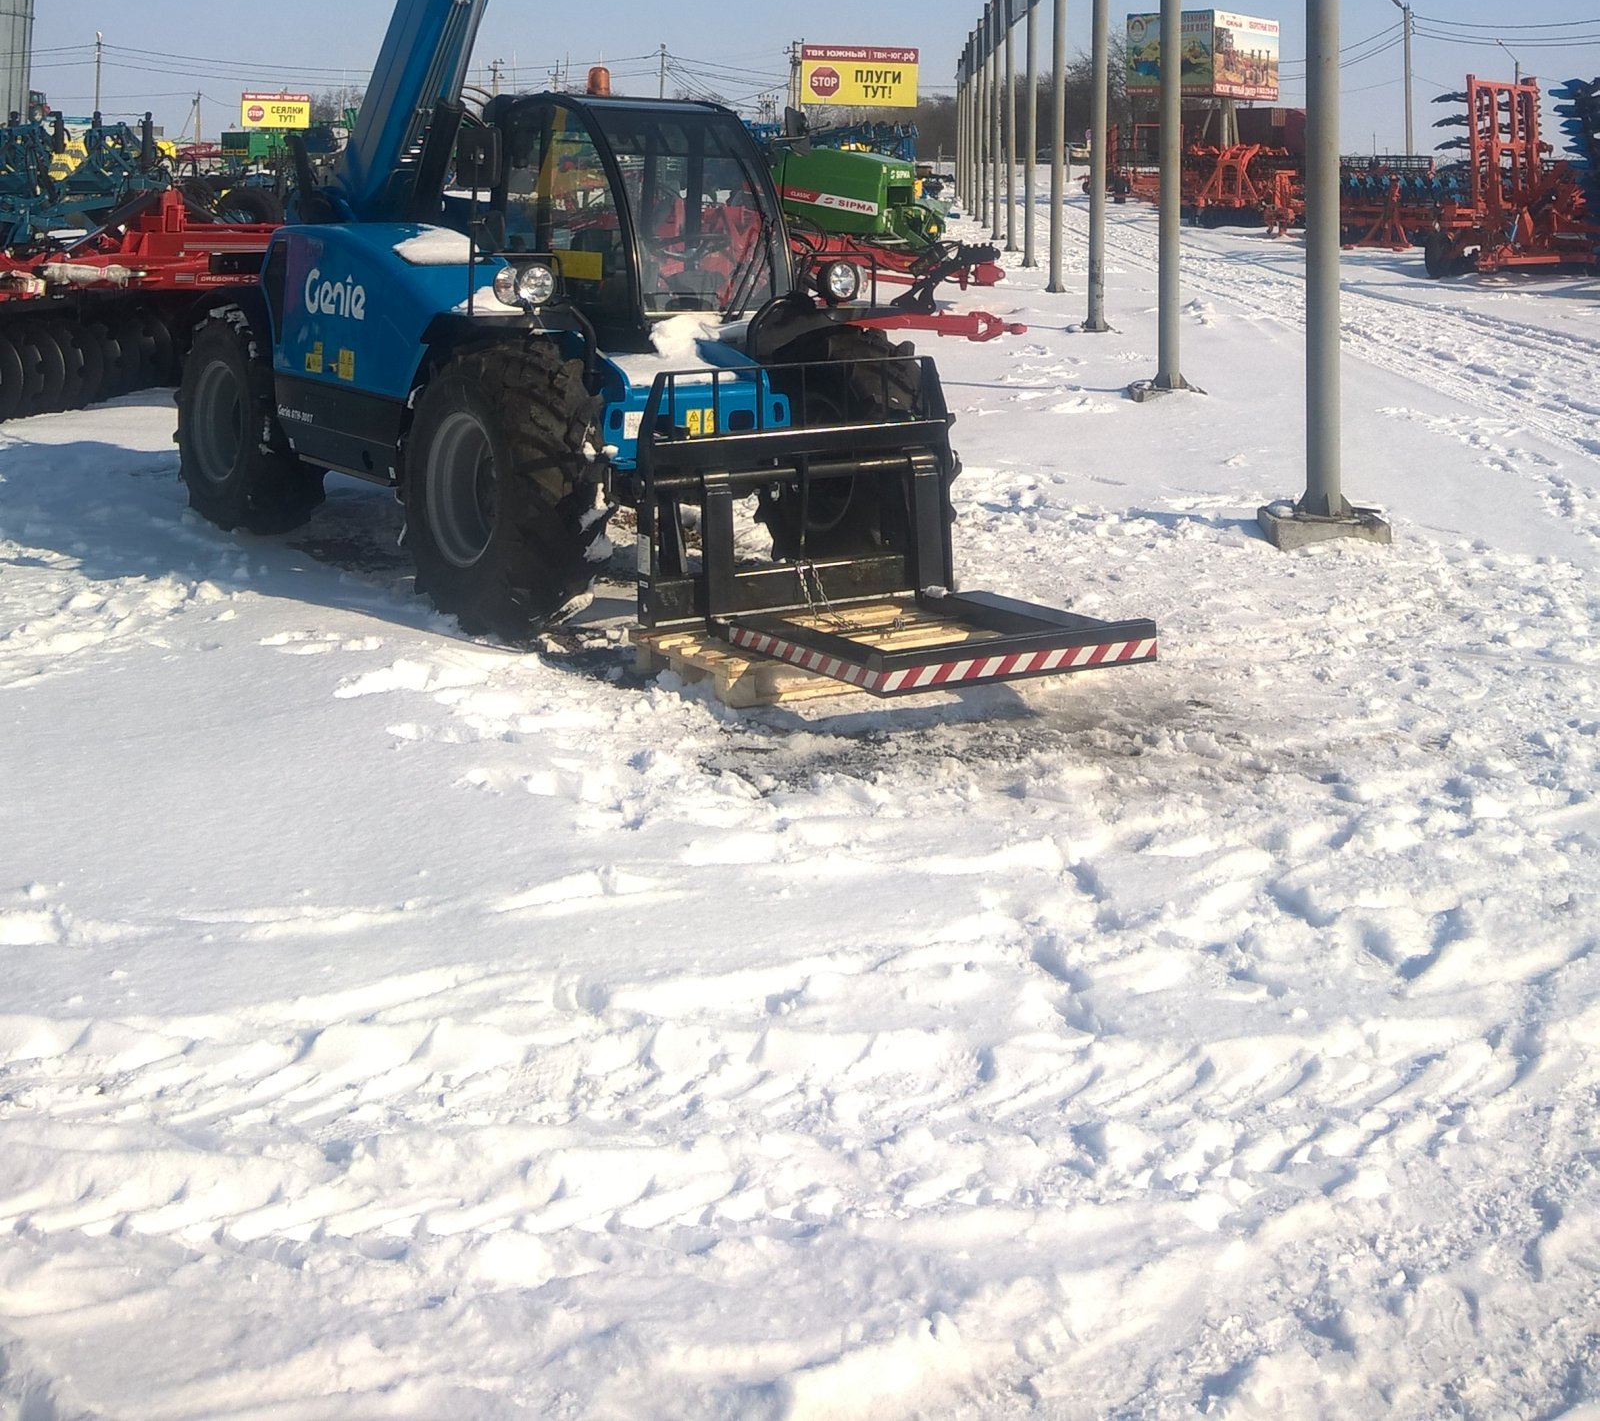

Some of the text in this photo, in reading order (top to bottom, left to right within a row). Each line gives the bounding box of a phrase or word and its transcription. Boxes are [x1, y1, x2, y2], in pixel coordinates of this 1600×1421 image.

[806, 49, 825, 57] ТВК
[826, 49, 867, 58] ЮЖНЫЙ
[811, 76, 838, 87] STOP
[855, 70, 902, 84] ПЛУГИ
[863, 85, 892, 99] ТУТ!
[271, 106, 304, 115] СЕЯЛКИ
[279, 114, 296, 123] ТУТ!
[896, 170, 911, 179] SIPMA
[790, 191, 874, 213] CLASSIC SIPMA
[305, 268, 366, 321] Genie
